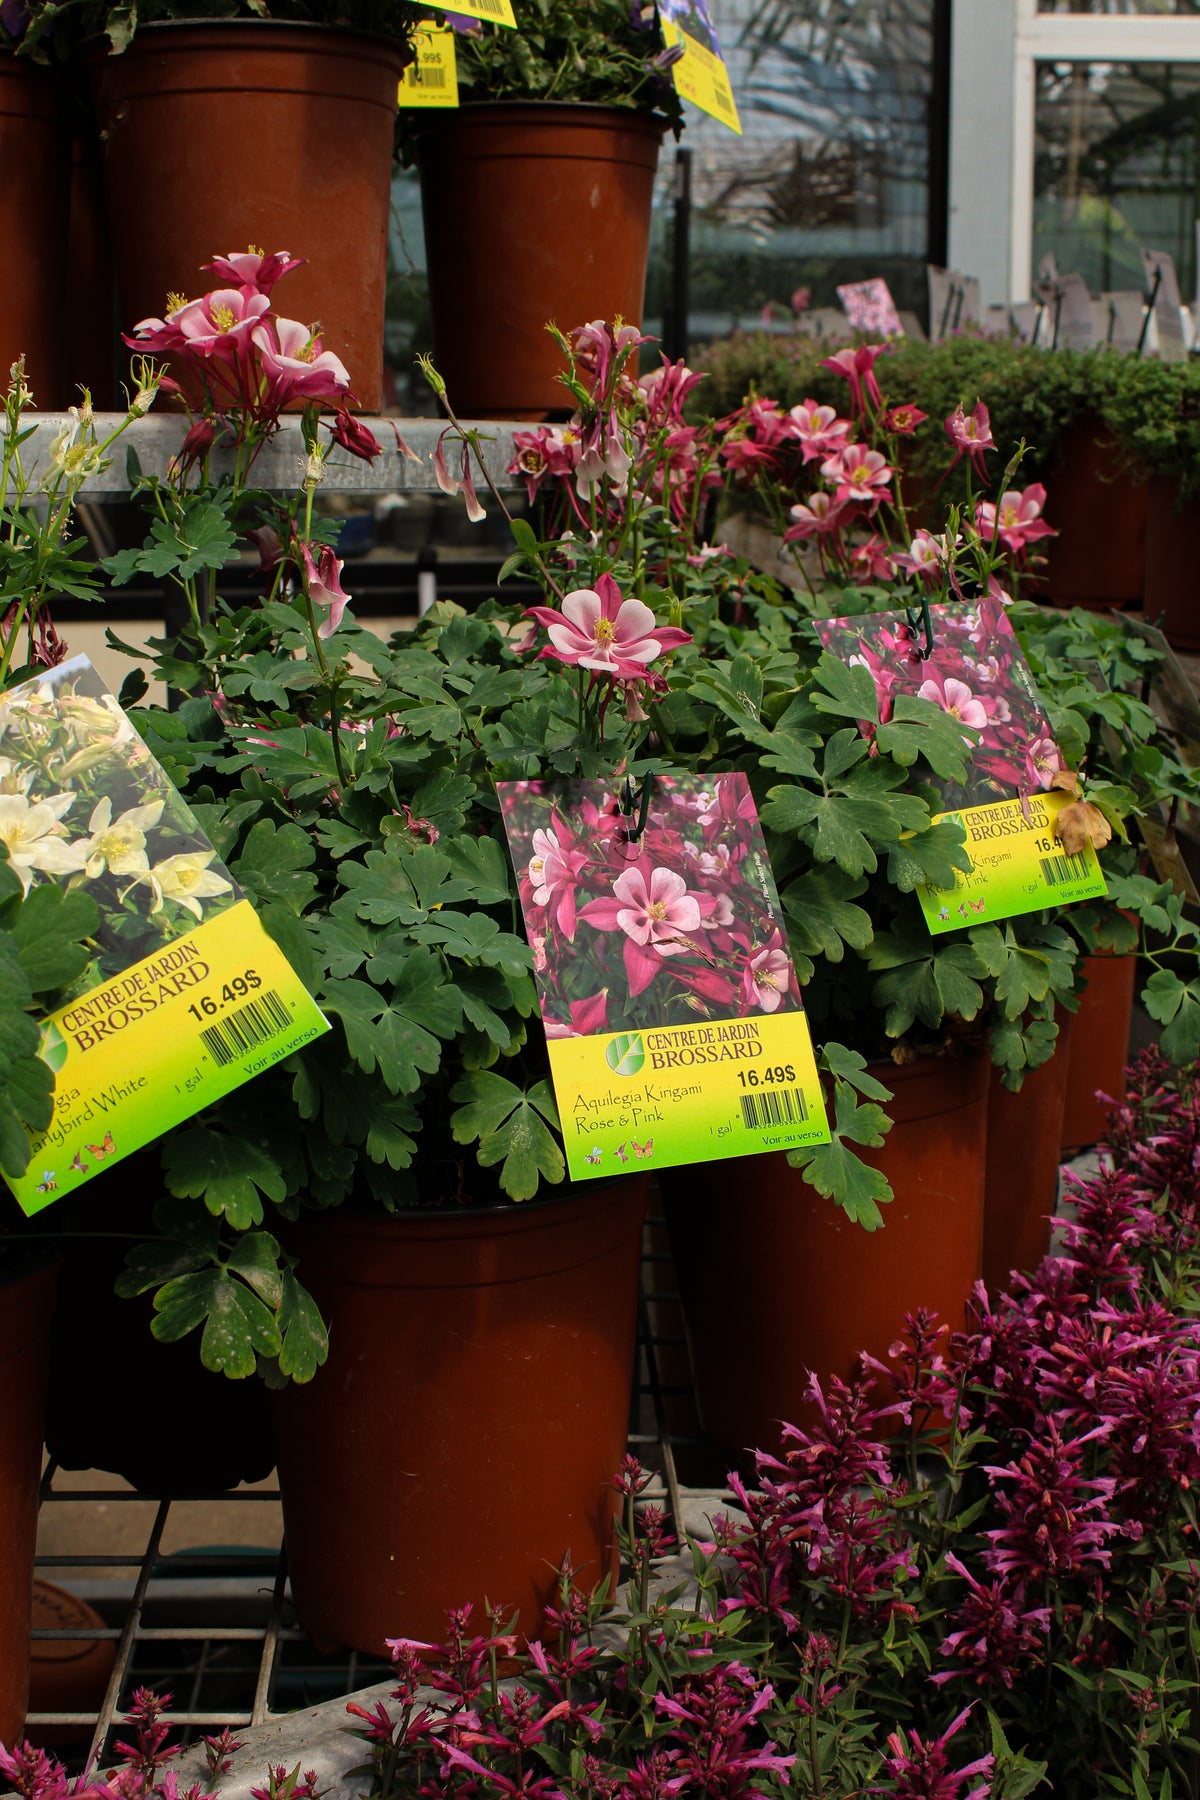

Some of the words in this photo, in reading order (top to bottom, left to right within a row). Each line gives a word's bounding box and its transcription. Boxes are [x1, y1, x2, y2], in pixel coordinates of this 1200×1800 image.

[965, 808, 1002, 826] CENTRE
[1000, 806, 1014, 819] DE
[1014, 800, 1045, 817] JADIN
[970, 815, 1049, 841] BROSSARD
[1034, 836, 1062, 852] 16.4
[970, 850, 1012, 868] Kirigami
[957, 879, 965, 889] &
[965, 874, 988, 888] Pink
[63, 986, 125, 1032] CENTRE
[121, 973, 147, 997] DE
[144, 941, 200, 984] JARDIN
[188, 970, 262, 1021] 16.49$
[73, 962, 209, 1052] BROSSARD
[647, 1030, 697, 1050] CENTRE
[697, 1028, 716, 1044] DE
[717, 1023, 759, 1042] JARDIN
[243, 1056, 268, 1075] Voir
[270, 1048, 286, 1060] au
[286, 1028, 318, 1050] verso
[650, 1041, 762, 1069] BROSSARD
[184, 1069, 204, 1092] gal
[738, 1065, 796, 1087] 16.49$
[573, 1090, 642, 1114] Aquilegia
[645, 1082, 702, 1102] Kirigami
[32, 1102, 94, 1157] arlybird
[92, 1077, 148, 1112] White
[576, 1117, 615, 1134] Rose
[619, 1115, 629, 1125] &
[632, 1106, 664, 1126] Pink
[718, 1120, 732, 1137] gal
[763, 1135, 782, 1145] Voir
[798, 1131, 823, 1139] verso
